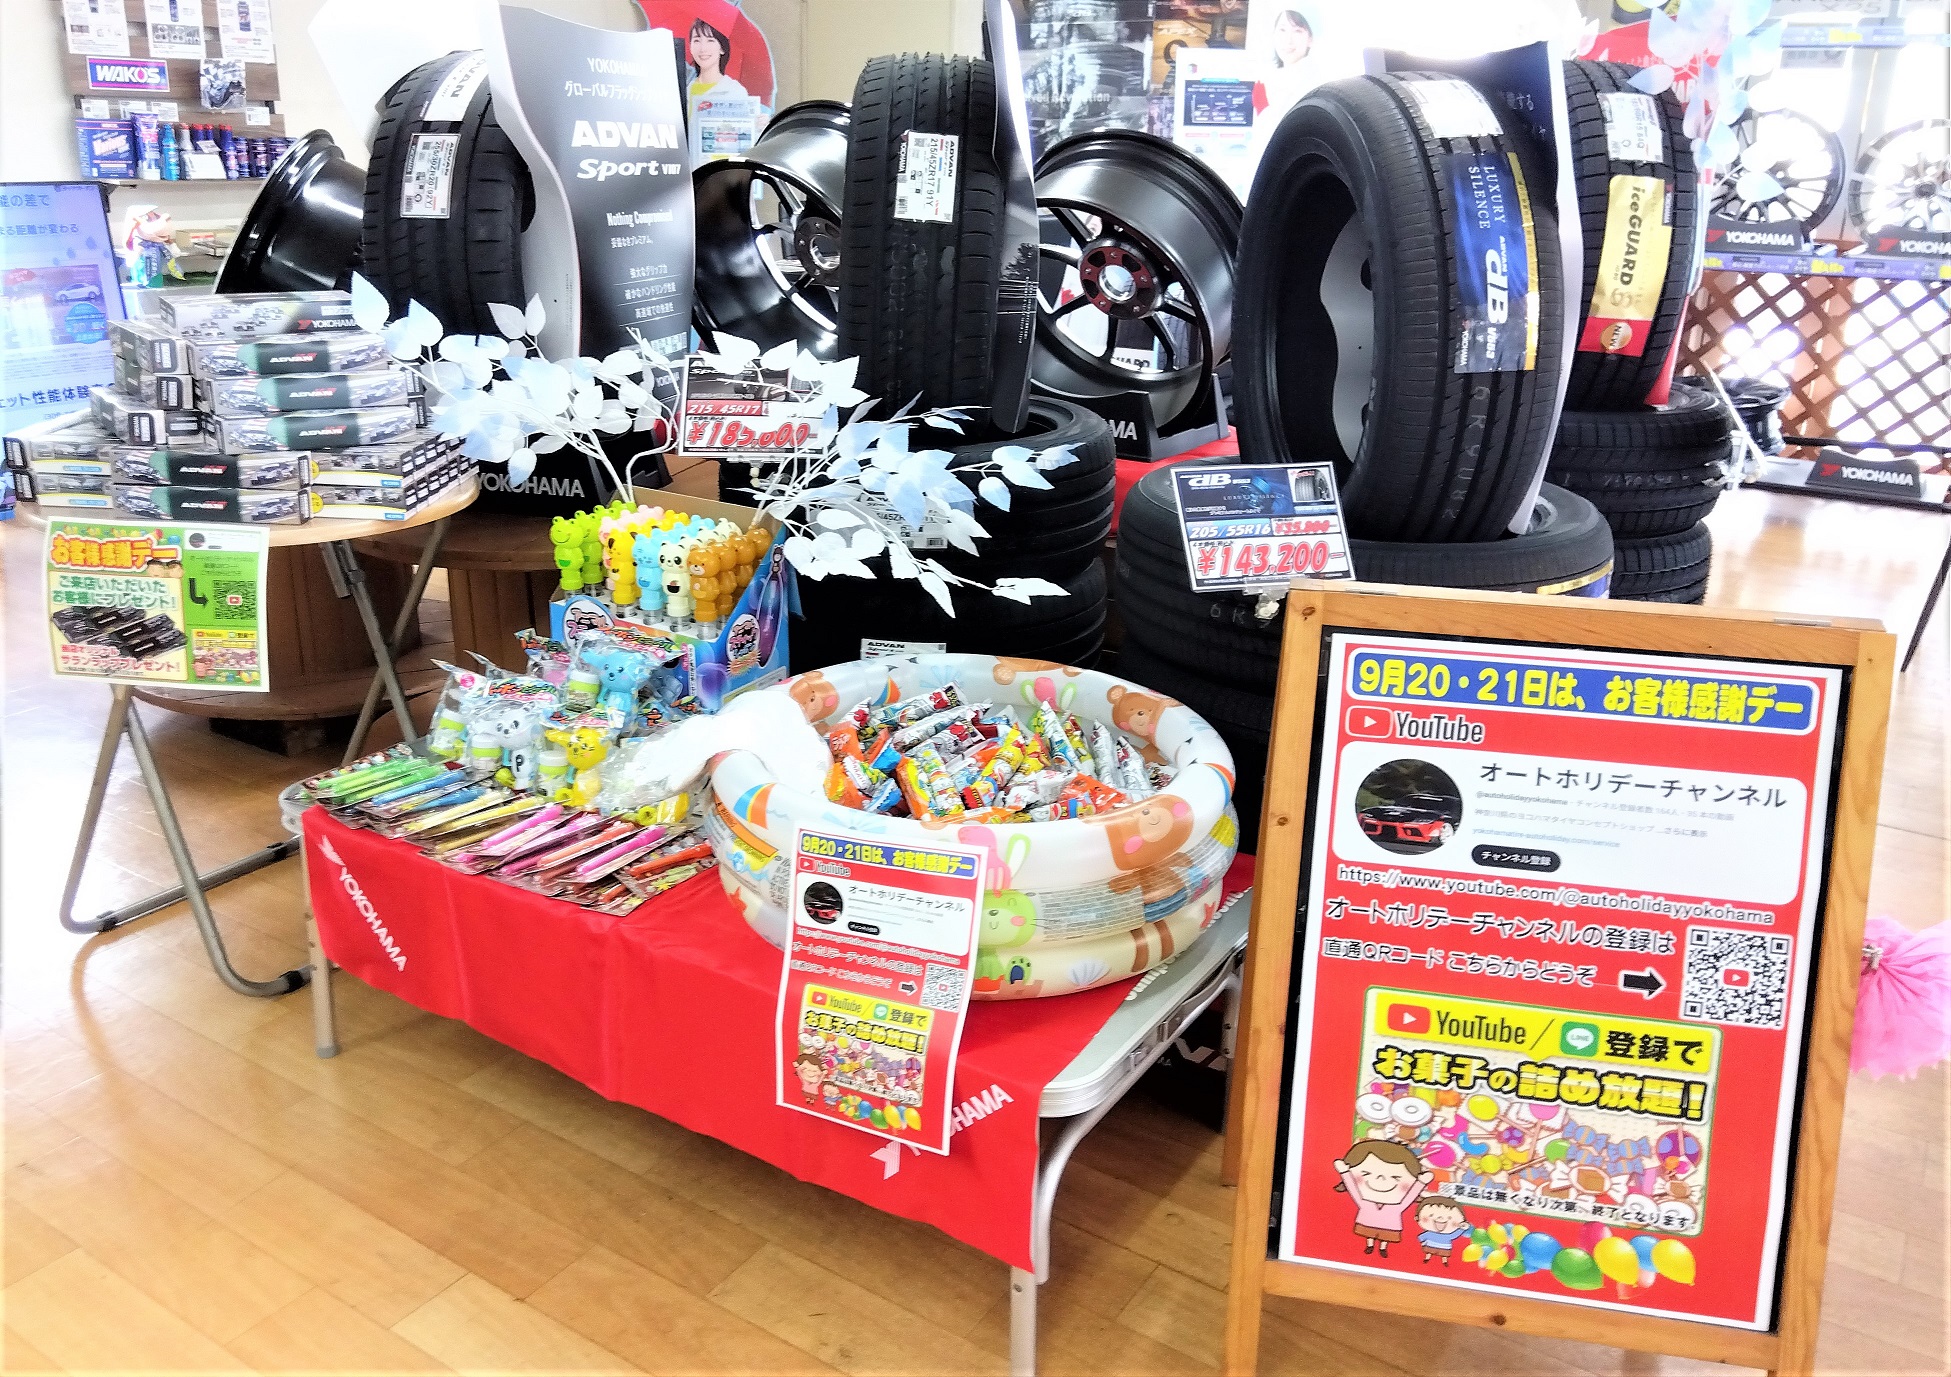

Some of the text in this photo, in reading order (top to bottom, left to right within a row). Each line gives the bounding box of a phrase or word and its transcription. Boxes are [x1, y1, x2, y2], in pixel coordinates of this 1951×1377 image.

[571, 120, 679, 149] ADVAN
[443, 143, 455, 177] ADVAN
[577, 159, 659, 181] Sport
[898, 142, 908, 172] YOKOHAMA
[947, 141, 956, 178] ADVAN
[925, 138, 938, 207] 215/45ZR17 91Y
[1468, 166, 1492, 229] SILENCE
[1483, 166, 1508, 224] LUXURY
[1619, 185, 1646, 286] iceGUARD
[1726, 231, 1795, 247] YOKOHAMA
[1498, 235, 1509, 273] ADVAN
[1486, 249, 1509, 323] dB
[1459, 330, 1469, 366] YOKOHAMA
[1608, 326, 1623, 348] NEW
[289, 390, 334, 398] ADVAN
[687, 404, 761, 415] 215/45R17
[299, 429, 343, 437] ADVAN
[180, 466, 224, 474] ADVAN
[1188, 473, 1232, 486] dB
[1841, 467, 1913, 486] YOKOHAMA
[180, 501, 224, 509] ADVAN
[1190, 523, 1271, 539] 205/55R16
[51, 534, 178, 569] お客様感謝デー
[59, 575, 167, 594] ご来店いただいた
[1397, 712, 1483, 742] YouTube
[1480, 763, 1787, 808] オートホリデーチャンネル
[816, 861, 851, 877] YouTube
[1481, 851, 1552, 866] チャンネル登録
[848, 885, 966, 913] オートホリデーチャンネル
[1338, 866, 1773, 923] https://www.youtube.com/@autoholidayyokohama
[339, 866, 408, 972] YOKOHAMA
[1326, 897, 1674, 954] オートホリデーチャンネルの登録は
[1324, 938, 1596, 986] 直通QRコード こちらからどうぞ
[829, 994, 928, 1027] YouTube 登録で
[1436, 1009, 1527, 1045] YouTube
[1605, 1031, 1703, 1065] 登録で
